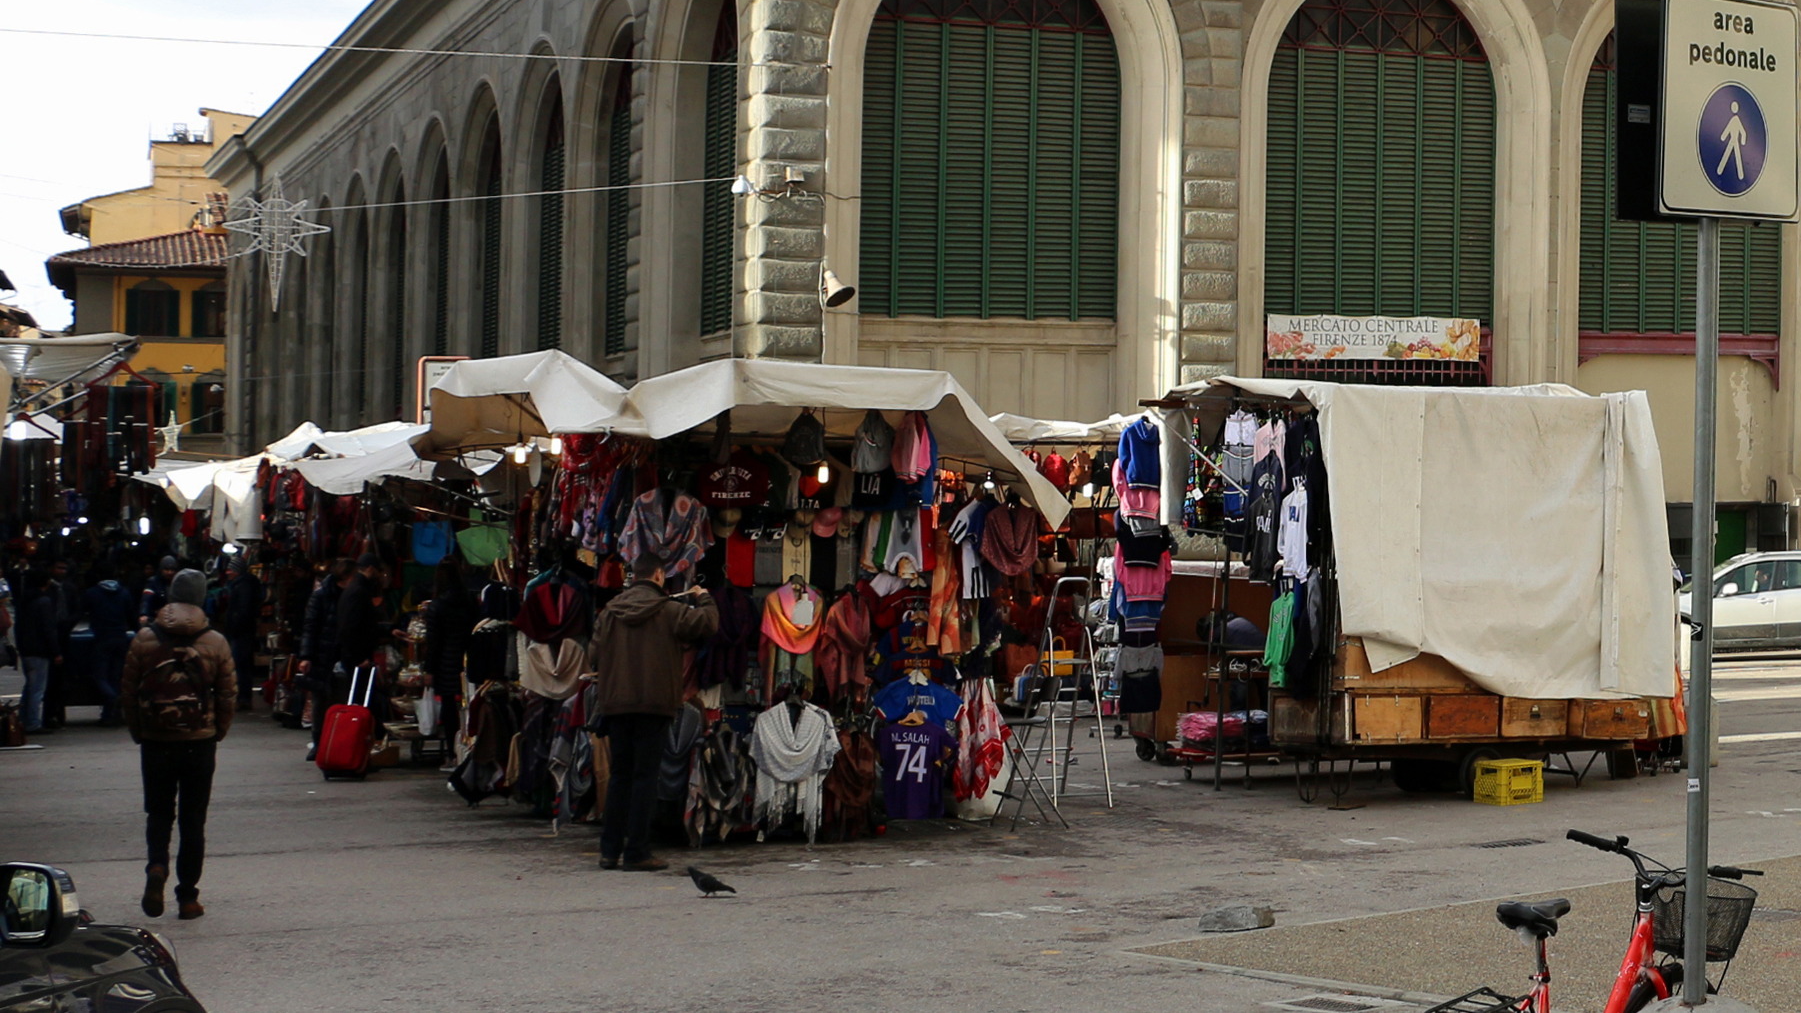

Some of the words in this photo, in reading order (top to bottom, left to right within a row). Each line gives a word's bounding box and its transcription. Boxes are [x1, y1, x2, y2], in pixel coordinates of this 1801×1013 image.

[1714, 12, 1754, 35] area
[1689, 42, 1776, 72] pedonale
[1288, 318, 1361, 333] MERCATO
[1365, 319, 1439, 333] CENTRALE
[1313, 334, 1367, 346] FIRENZE
[1372, 334, 1398, 347] 1874
[711, 491, 752, 499] FIRENZE
[902, 732, 930, 744] SALAH
[895, 744, 928, 783] 74
